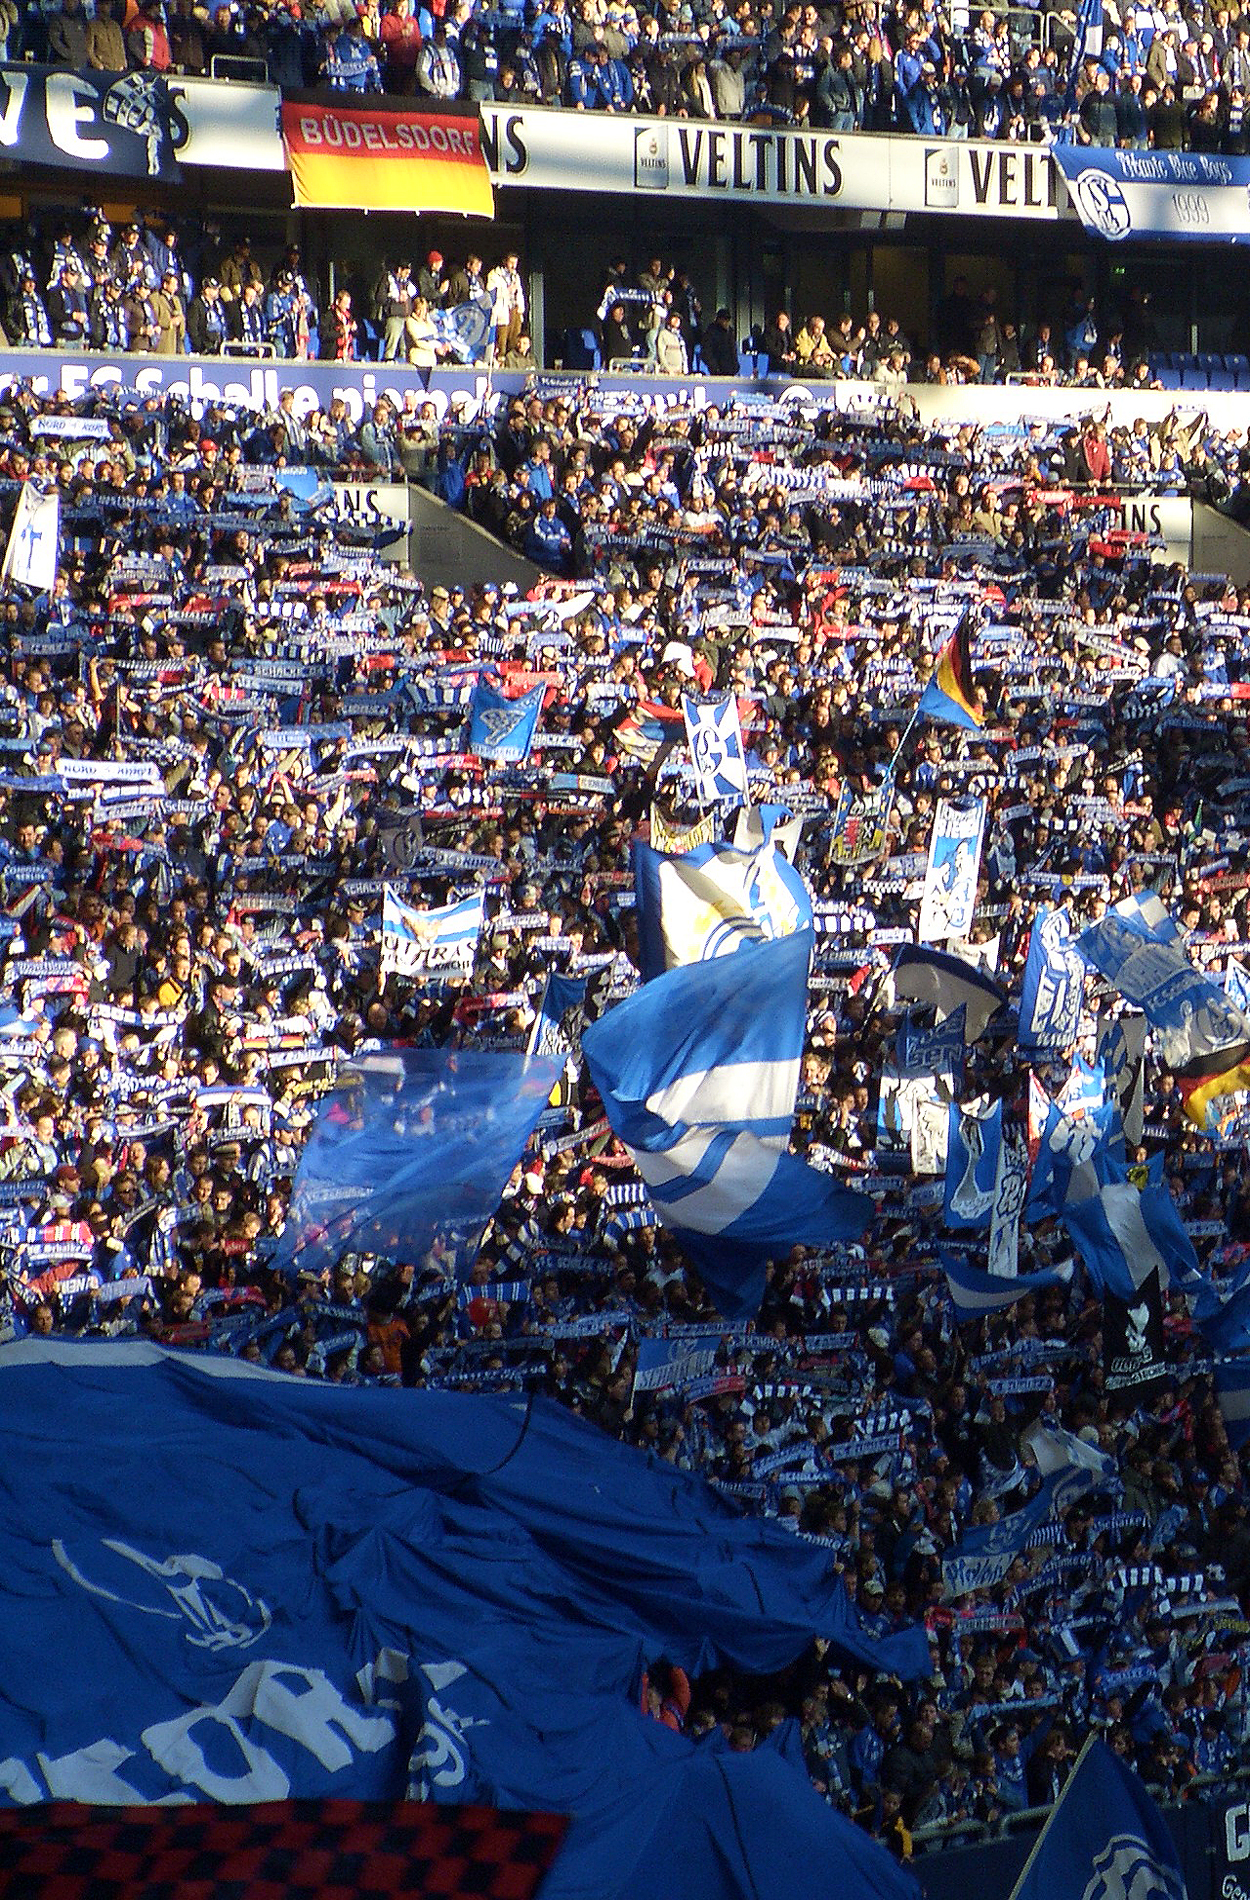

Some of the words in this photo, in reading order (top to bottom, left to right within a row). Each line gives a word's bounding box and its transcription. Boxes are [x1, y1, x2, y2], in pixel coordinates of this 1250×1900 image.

[301, 114, 475, 157] BÜDELSDORF
[678, 129, 844, 197] VELTINS
[969, 149, 1058, 208] VELT
[1169, 154, 1198, 182] Blue
[1201, 157, 1233, 185] Boys
[1172, 193, 1210, 224] 1999
[254, 664, 304, 677] SCHALKE
[344, 881, 386, 896] SCHALK
